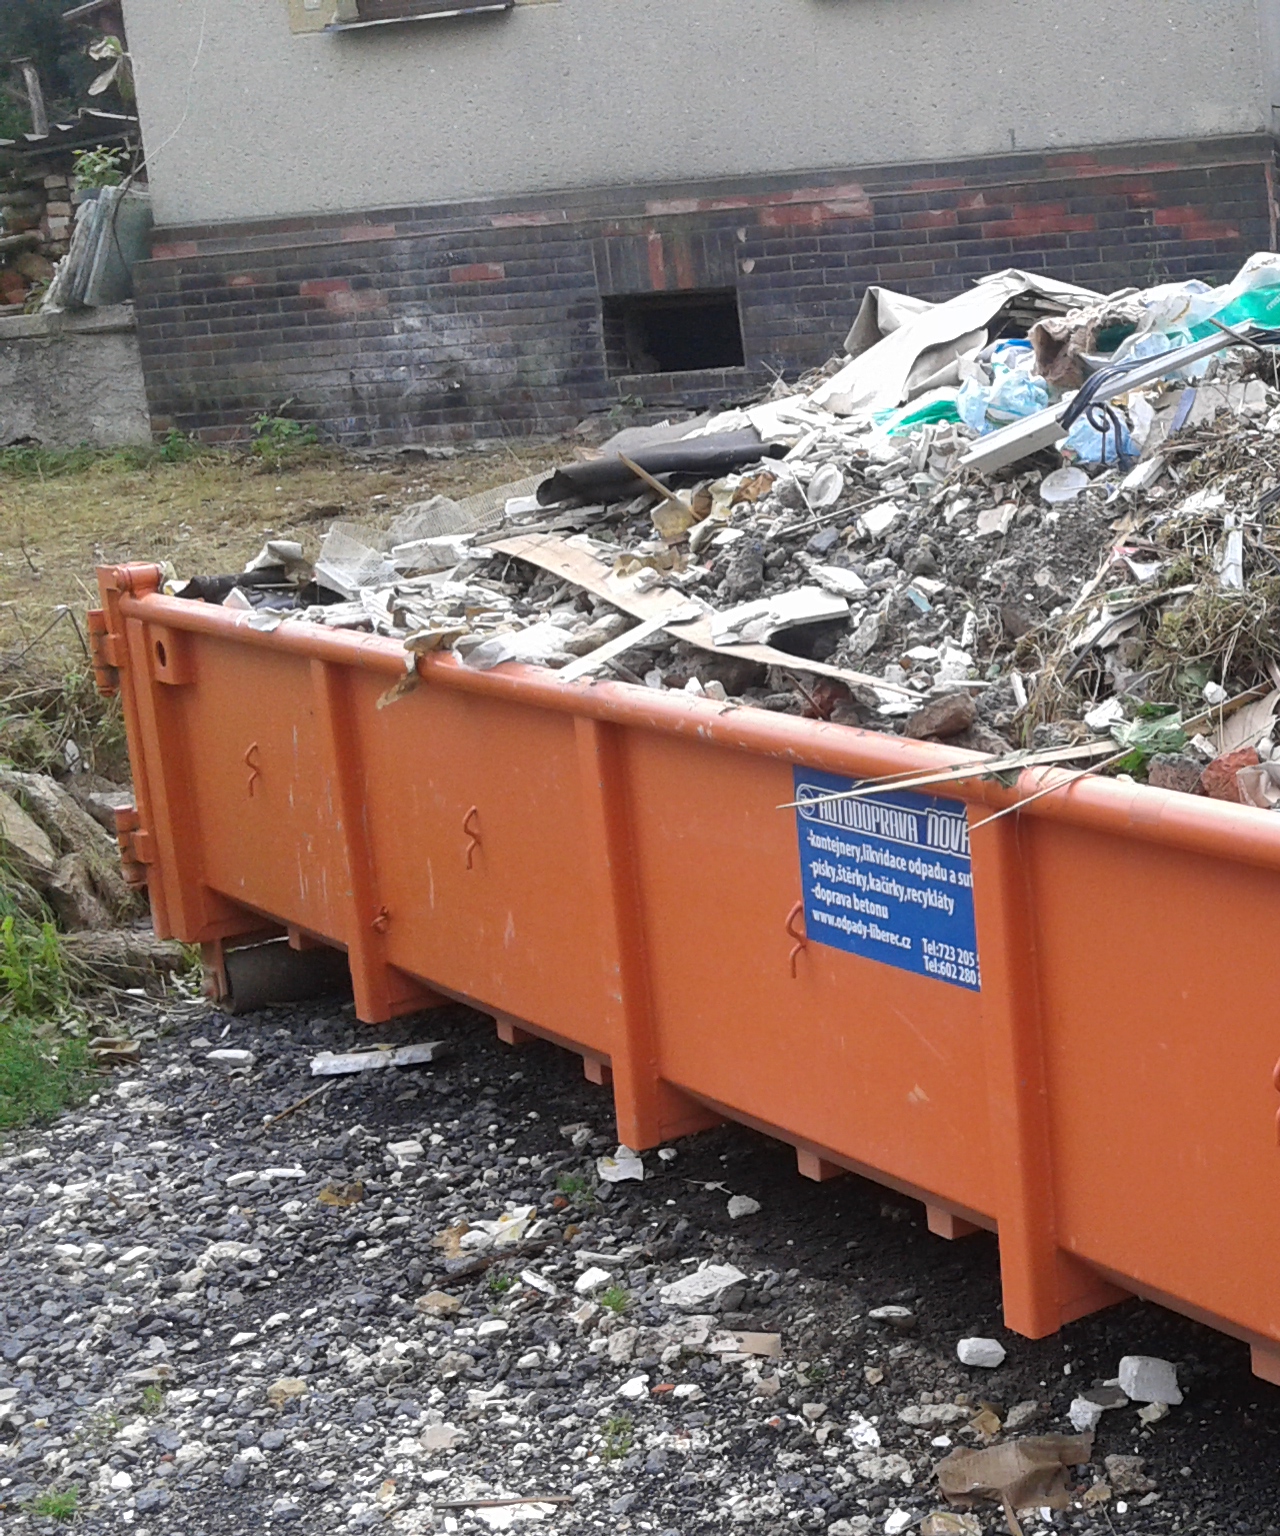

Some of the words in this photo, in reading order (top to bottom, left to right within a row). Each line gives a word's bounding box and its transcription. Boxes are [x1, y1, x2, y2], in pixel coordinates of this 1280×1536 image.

[818, 793, 919, 843] AUTODOPRAVA
[908, 857, 948, 881] odpadu
[949, 869, 957, 884] a
[853, 892, 889, 920] betonu
[812, 909, 912, 950] www.odpady-liberec.cz
[921, 937, 956, 961] Tel:723
[956, 947, 976, 967] 205
[922, 955, 957, 979] Tel:602
[958, 965, 977, 985] 280
